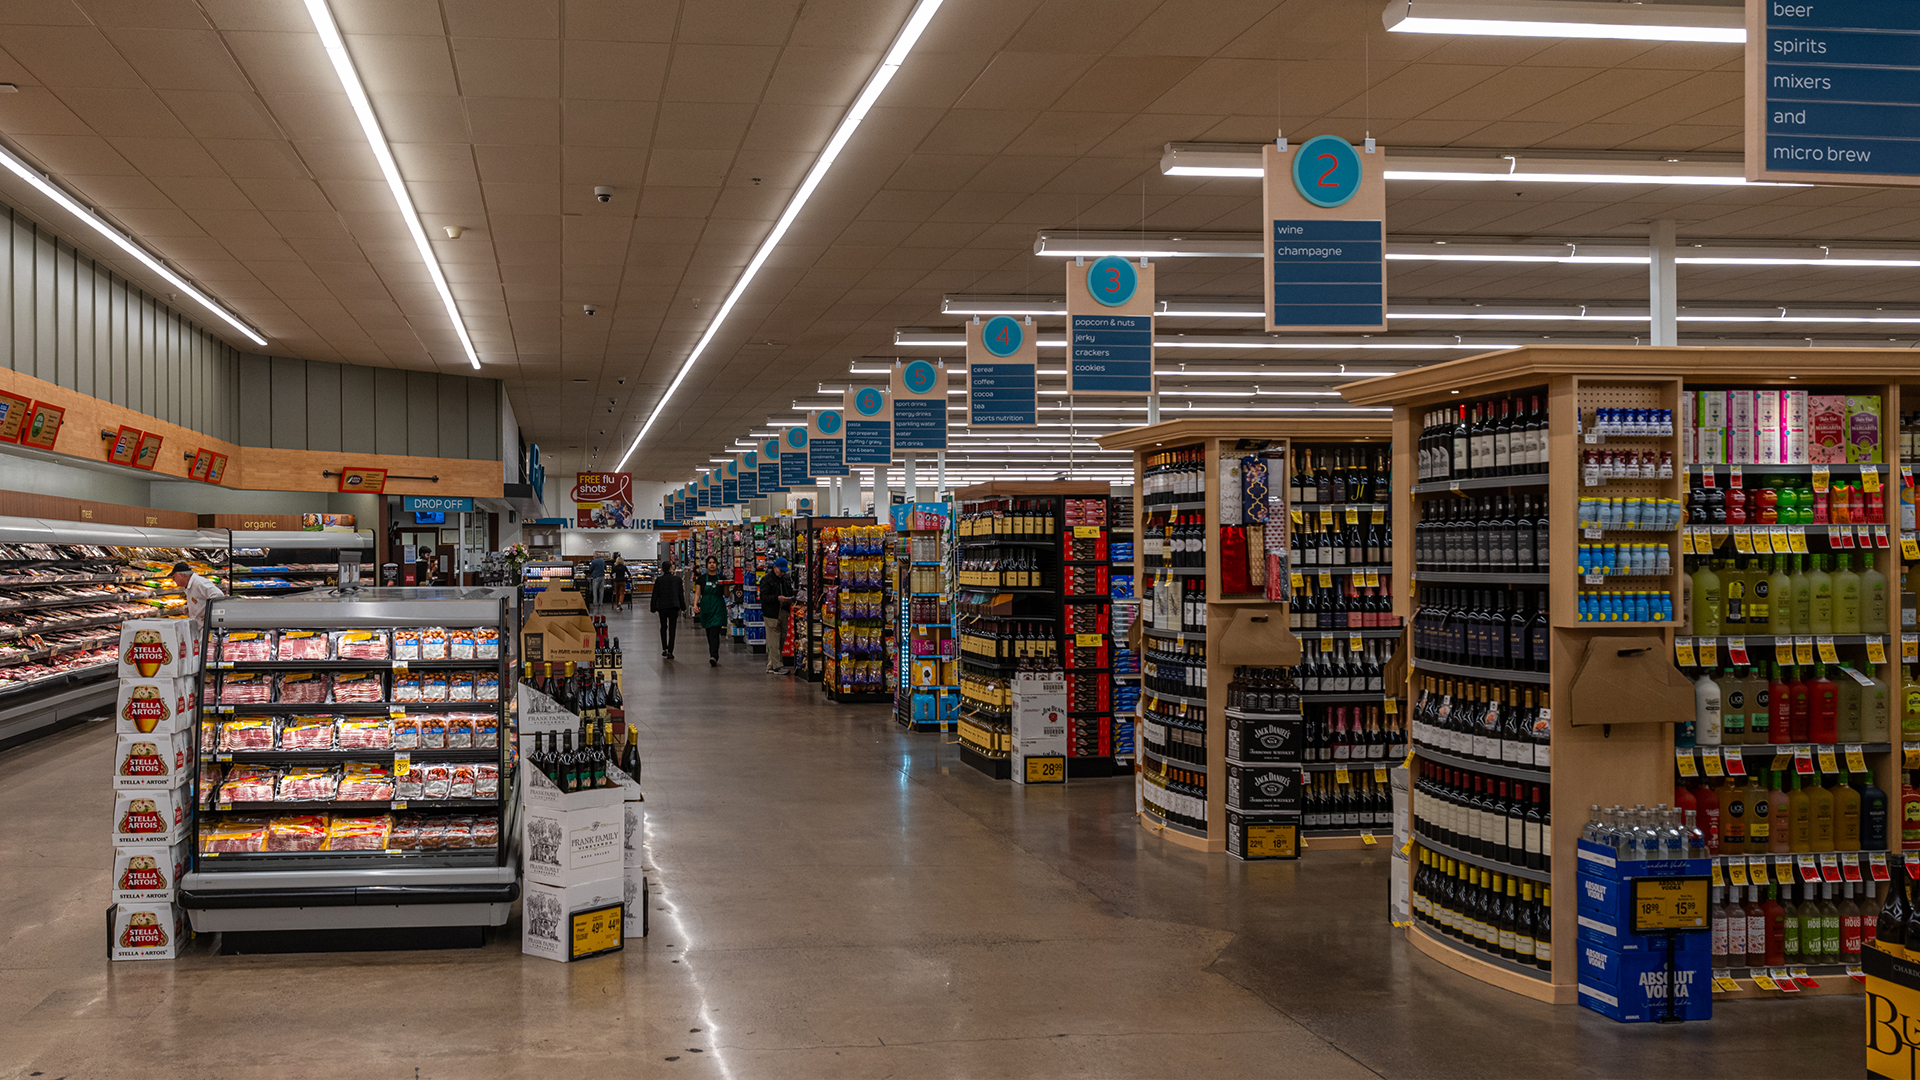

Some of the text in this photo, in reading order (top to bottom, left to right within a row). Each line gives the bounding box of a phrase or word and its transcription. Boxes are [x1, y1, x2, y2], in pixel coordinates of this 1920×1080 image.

[1773, 1, 1814, 17] beer
[1773, 38, 1827, 55] spirits
[1773, 73, 1831, 90] mixers
[1773, 110, 1806, 124] and
[1773, 145, 1871, 162] micro brew
[1317, 153, 1339, 187] 2
[1277, 225, 1303, 235] wine
[1278, 246, 1342, 258] champagne
[1105, 268, 1120, 292] 3
[1075, 319, 1109, 327] popcorn
[1117, 319, 1135, 327] nuts
[996, 326, 1010, 345] 4
[1075, 333, 1095, 343] jerky
[1075, 348, 1110, 356] crackers
[1075, 364, 1105, 372] cookies
[915, 368, 926, 385] 5
[864, 394, 874, 408] 6
[826, 415, 834, 428] 7
[794, 432, 803, 443] 8
[770, 444, 778, 455] 9
[580, 474, 614, 484] FREE flu
[580, 484, 607, 493] shots
[414, 499, 463, 509] DROP OFF
[81, 508, 93, 519] meat
[244, 520, 277, 531] organic
[1254, 724, 1291, 740] JACK DANIEL'S
[1254, 772, 1291, 788] JACK DANIEL'S
[571, 831, 619, 848] FRANK FAMILY
[1585, 880, 1607, 895] ABSOLUT
[1587, 888, 1605, 902] VODKA
[1585, 947, 1608, 963] ABSOLUT
[1587, 956, 1606, 971] VODKA
